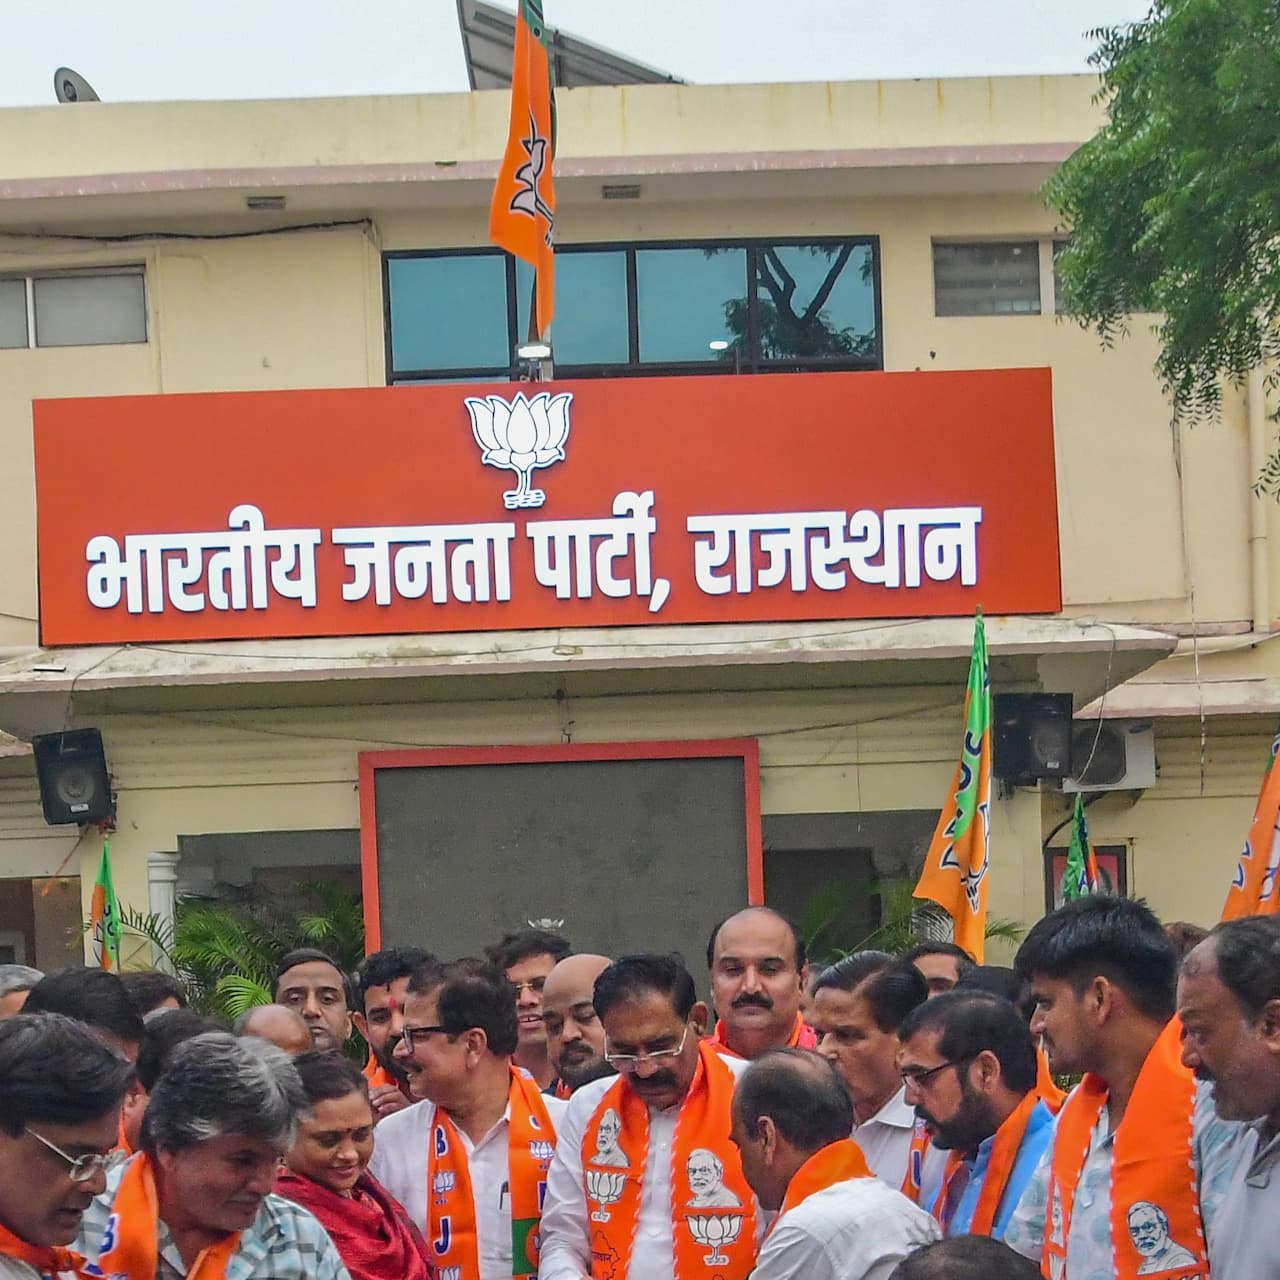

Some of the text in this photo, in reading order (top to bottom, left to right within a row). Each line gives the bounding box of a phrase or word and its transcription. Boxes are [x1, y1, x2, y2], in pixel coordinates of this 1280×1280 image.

[85, 490, 983, 614] भारतीय जनता पार्टी, राजस्थान
